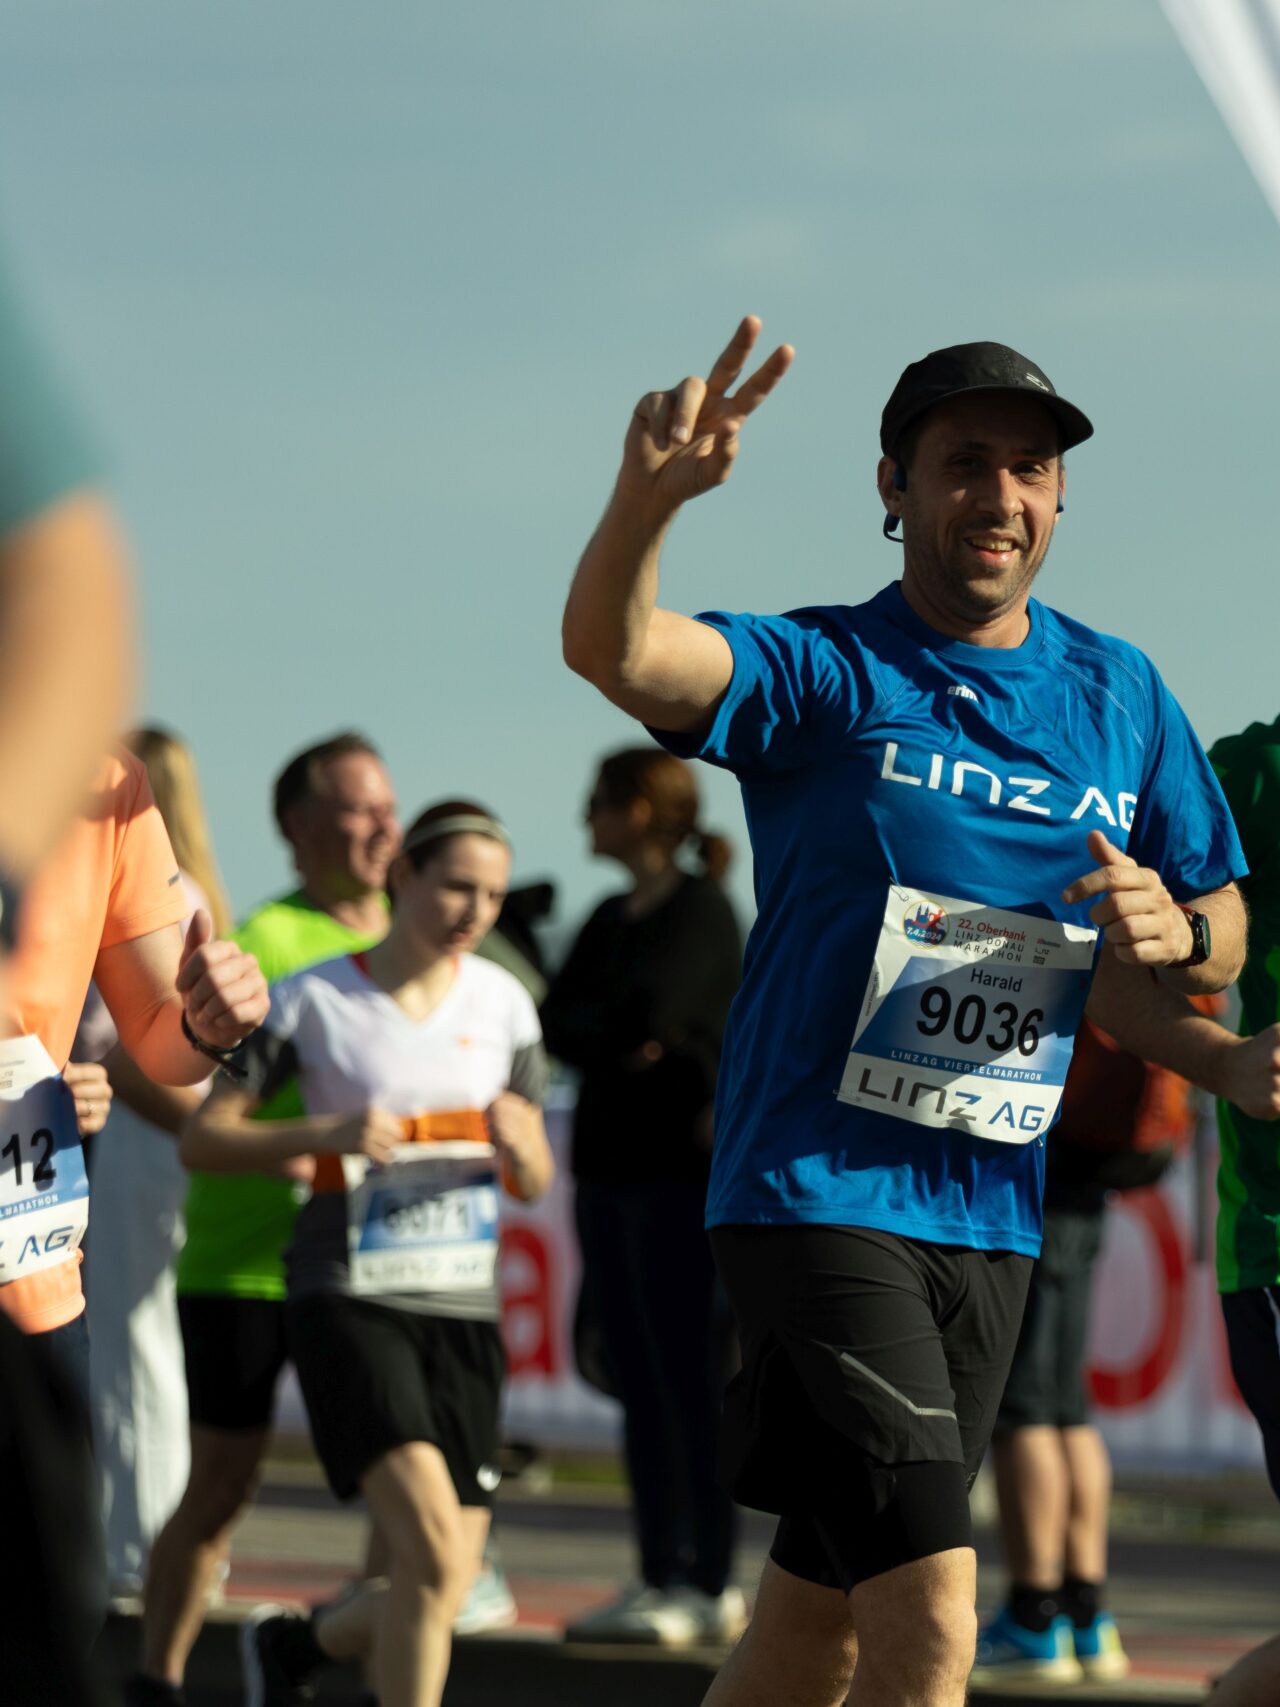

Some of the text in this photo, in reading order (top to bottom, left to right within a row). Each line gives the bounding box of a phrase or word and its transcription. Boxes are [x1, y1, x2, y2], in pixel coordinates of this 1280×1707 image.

[1070, 786, 1138, 832] AG
[955, 931, 981, 943] LINZ
[986, 936, 1025, 953] DONAU
[957, 918, 1027, 942] 22. Oberbank
[953, 940, 1022, 963] MARATHON
[970, 968, 1023, 993] Harald
[916, 986, 1044, 1057] 9036
[944, 1060, 1042, 1081] VIERTELMARATHON
[988, 1101, 1046, 1131] AG
[2, 1128, 57, 1186] 12
[18, 1225, 74, 1264] AG
